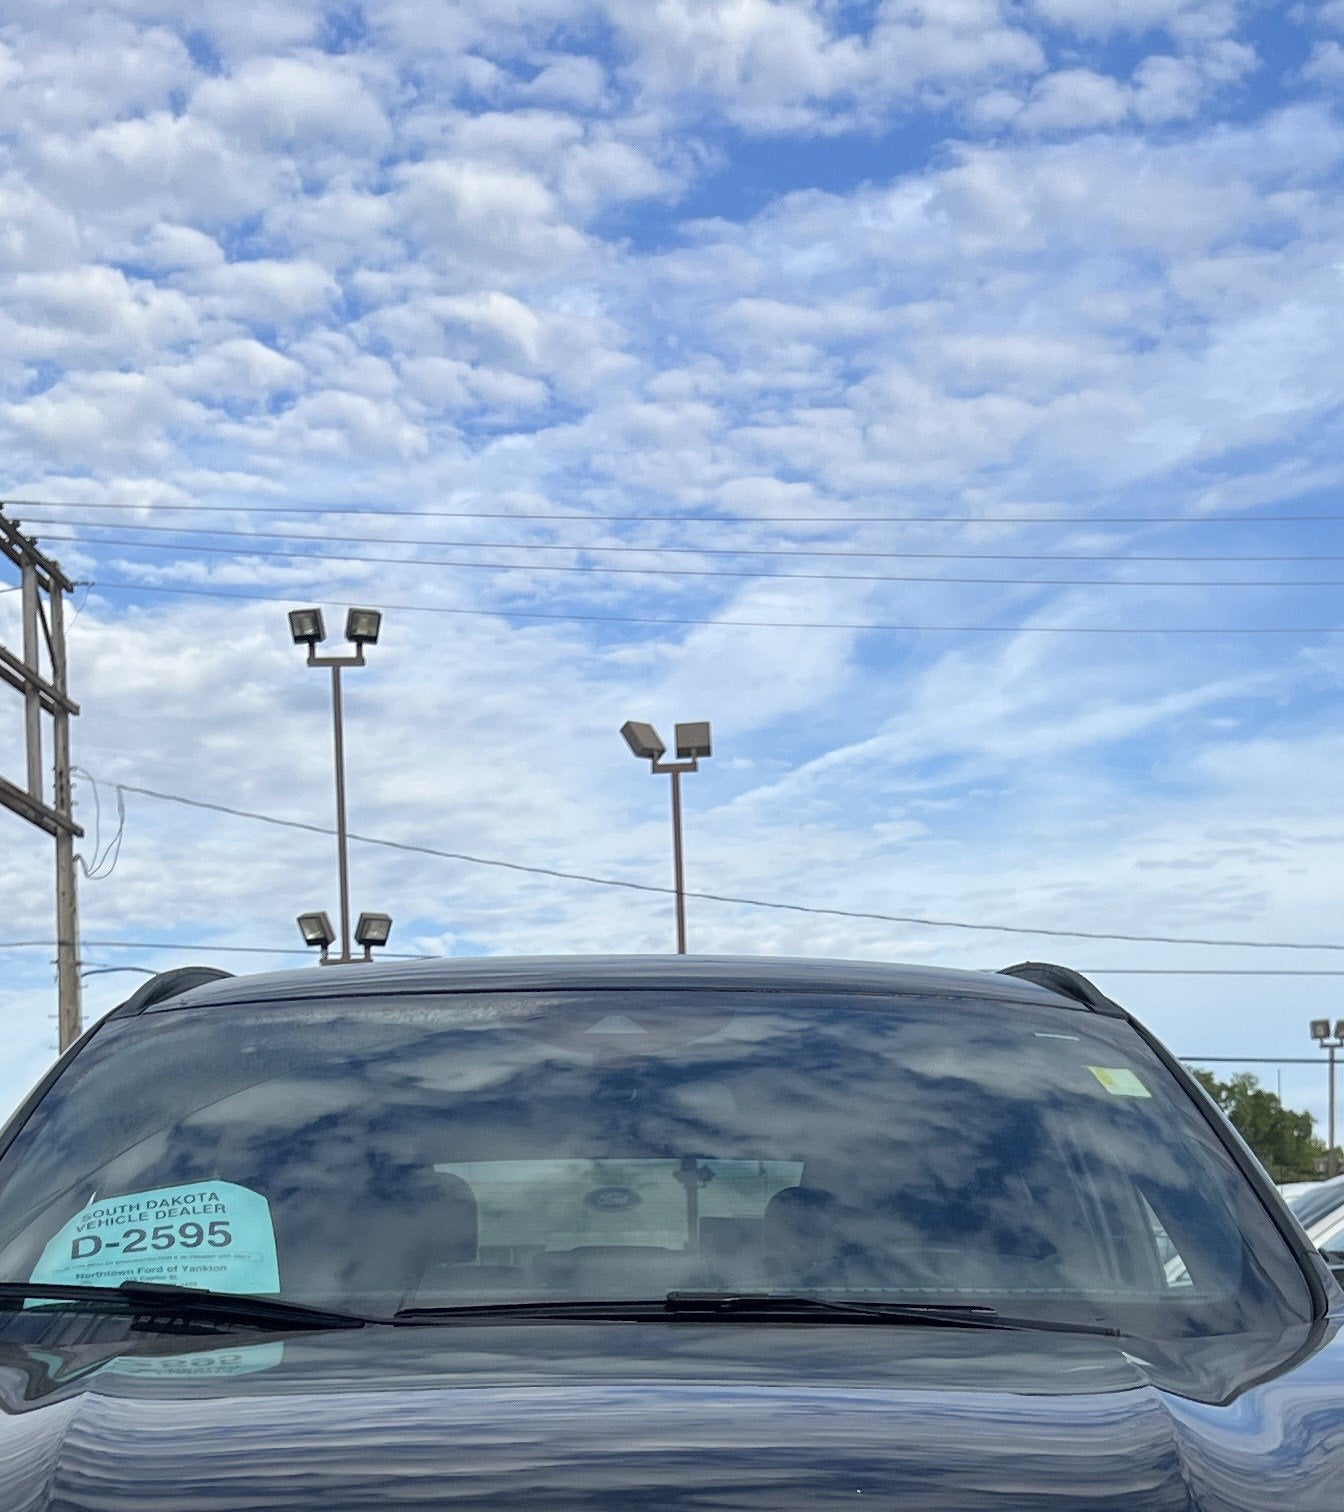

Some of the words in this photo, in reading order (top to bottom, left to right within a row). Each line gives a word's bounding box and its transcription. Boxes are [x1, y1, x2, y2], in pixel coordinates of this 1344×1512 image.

[76, 1211, 150, 1232] VEHICLE
[155, 1203, 226, 1220] DEALER
[82, 1202, 140, 1222] SOUTH
[146, 1192, 220, 1210] DAKOTA
[70, 1221, 233, 1260] D-2595
[137, 1265, 164, 1274] Ford
[181, 1264, 228, 1273] Yankton
